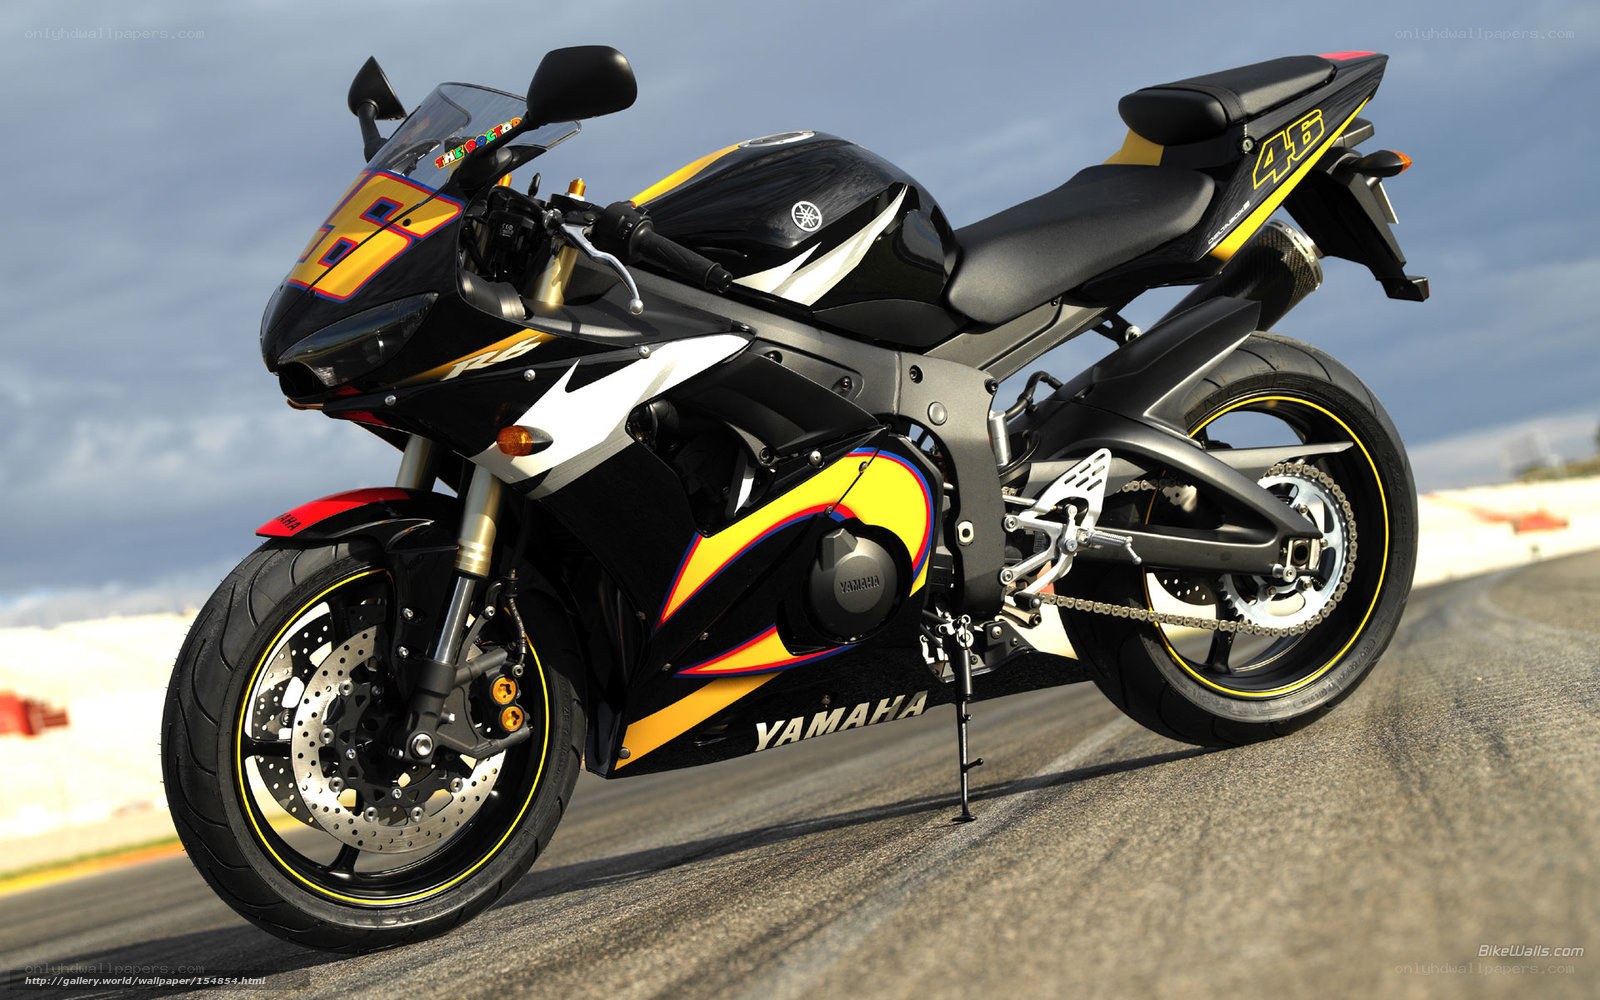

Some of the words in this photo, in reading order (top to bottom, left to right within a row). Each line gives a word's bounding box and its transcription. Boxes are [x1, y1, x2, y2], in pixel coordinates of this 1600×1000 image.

[434, 144, 465, 169] THE
[1252, 109, 1325, 190] 46
[441, 334, 542, 382] R6
[840, 575, 880, 593] YAMAHA
[755, 690, 928, 752] YAMAHA
